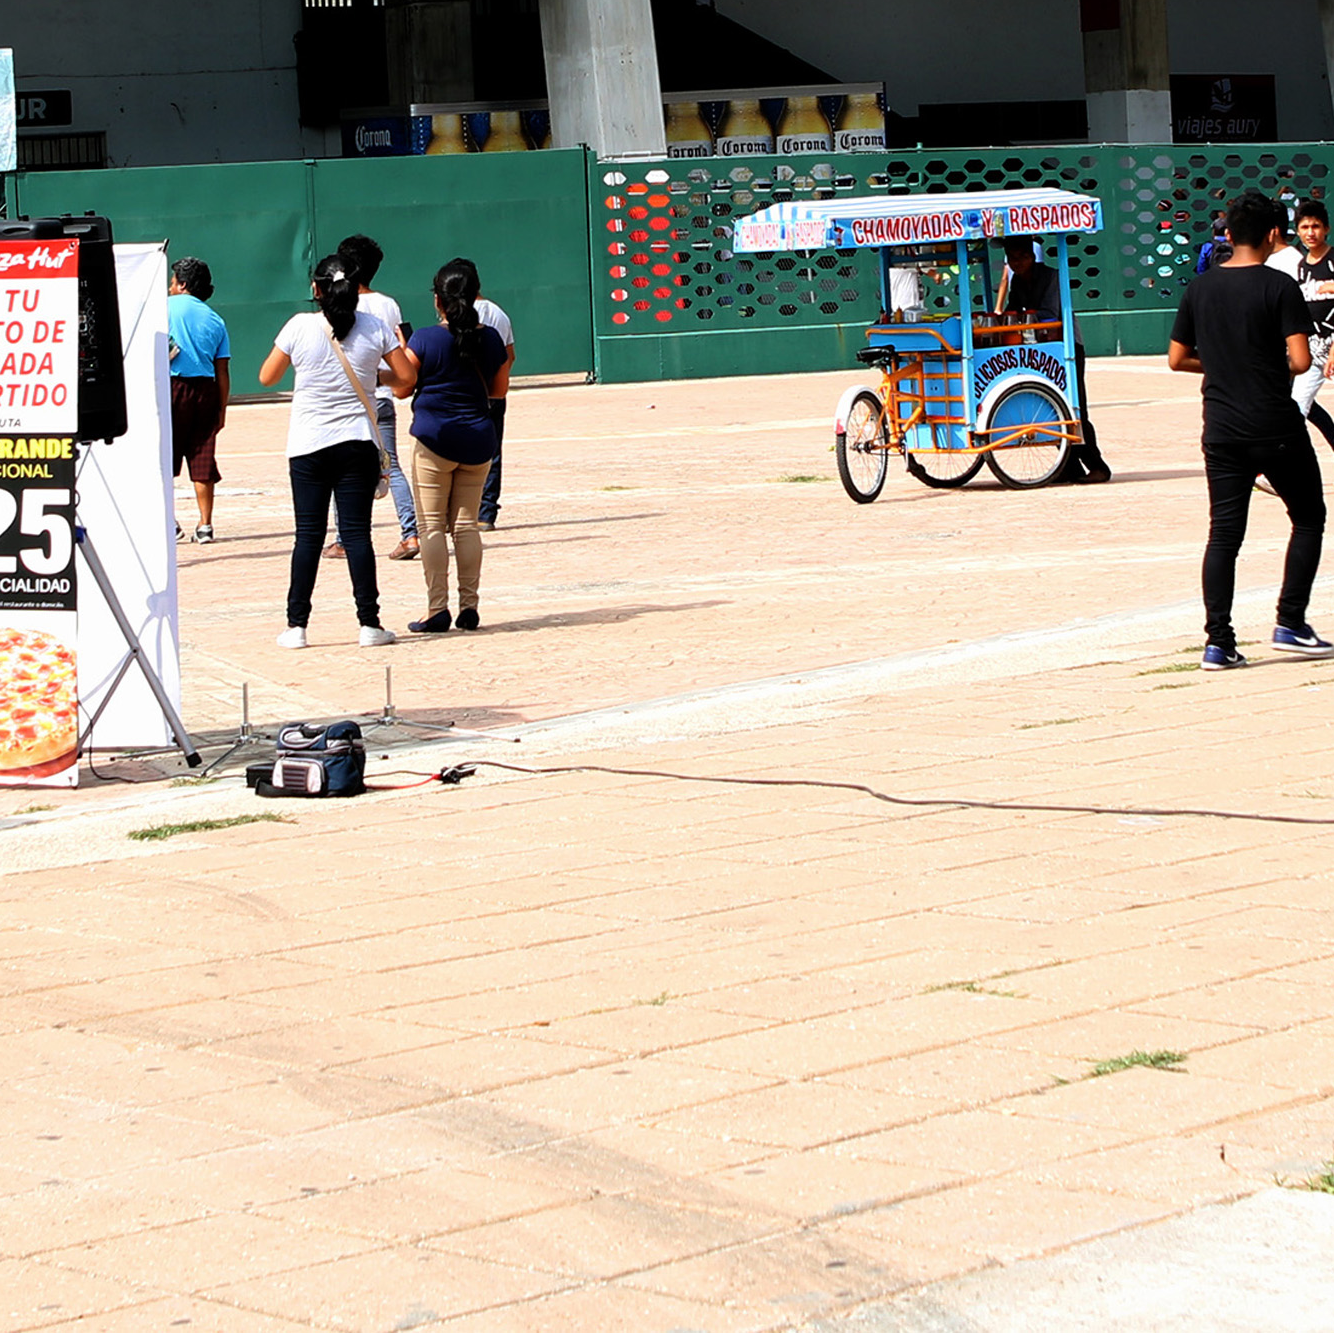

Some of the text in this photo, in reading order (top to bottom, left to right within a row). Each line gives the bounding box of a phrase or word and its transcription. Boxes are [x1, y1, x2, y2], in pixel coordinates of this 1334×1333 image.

[1178, 116, 1260, 139] viajes aury
[355, 125, 392, 154] Corona
[722, 140, 767, 156] Corona
[782, 138, 826, 153] Corona
[840, 132, 884, 149] Corona
[852, 203, 1092, 245] CHAMOYADAS Y RASPADOS
[27, 247, 74, 269] Hut
[5, 289, 40, 312] TU
[32, 320, 66, 343] DE
[1019, 347, 1067, 392] RASPADOS
